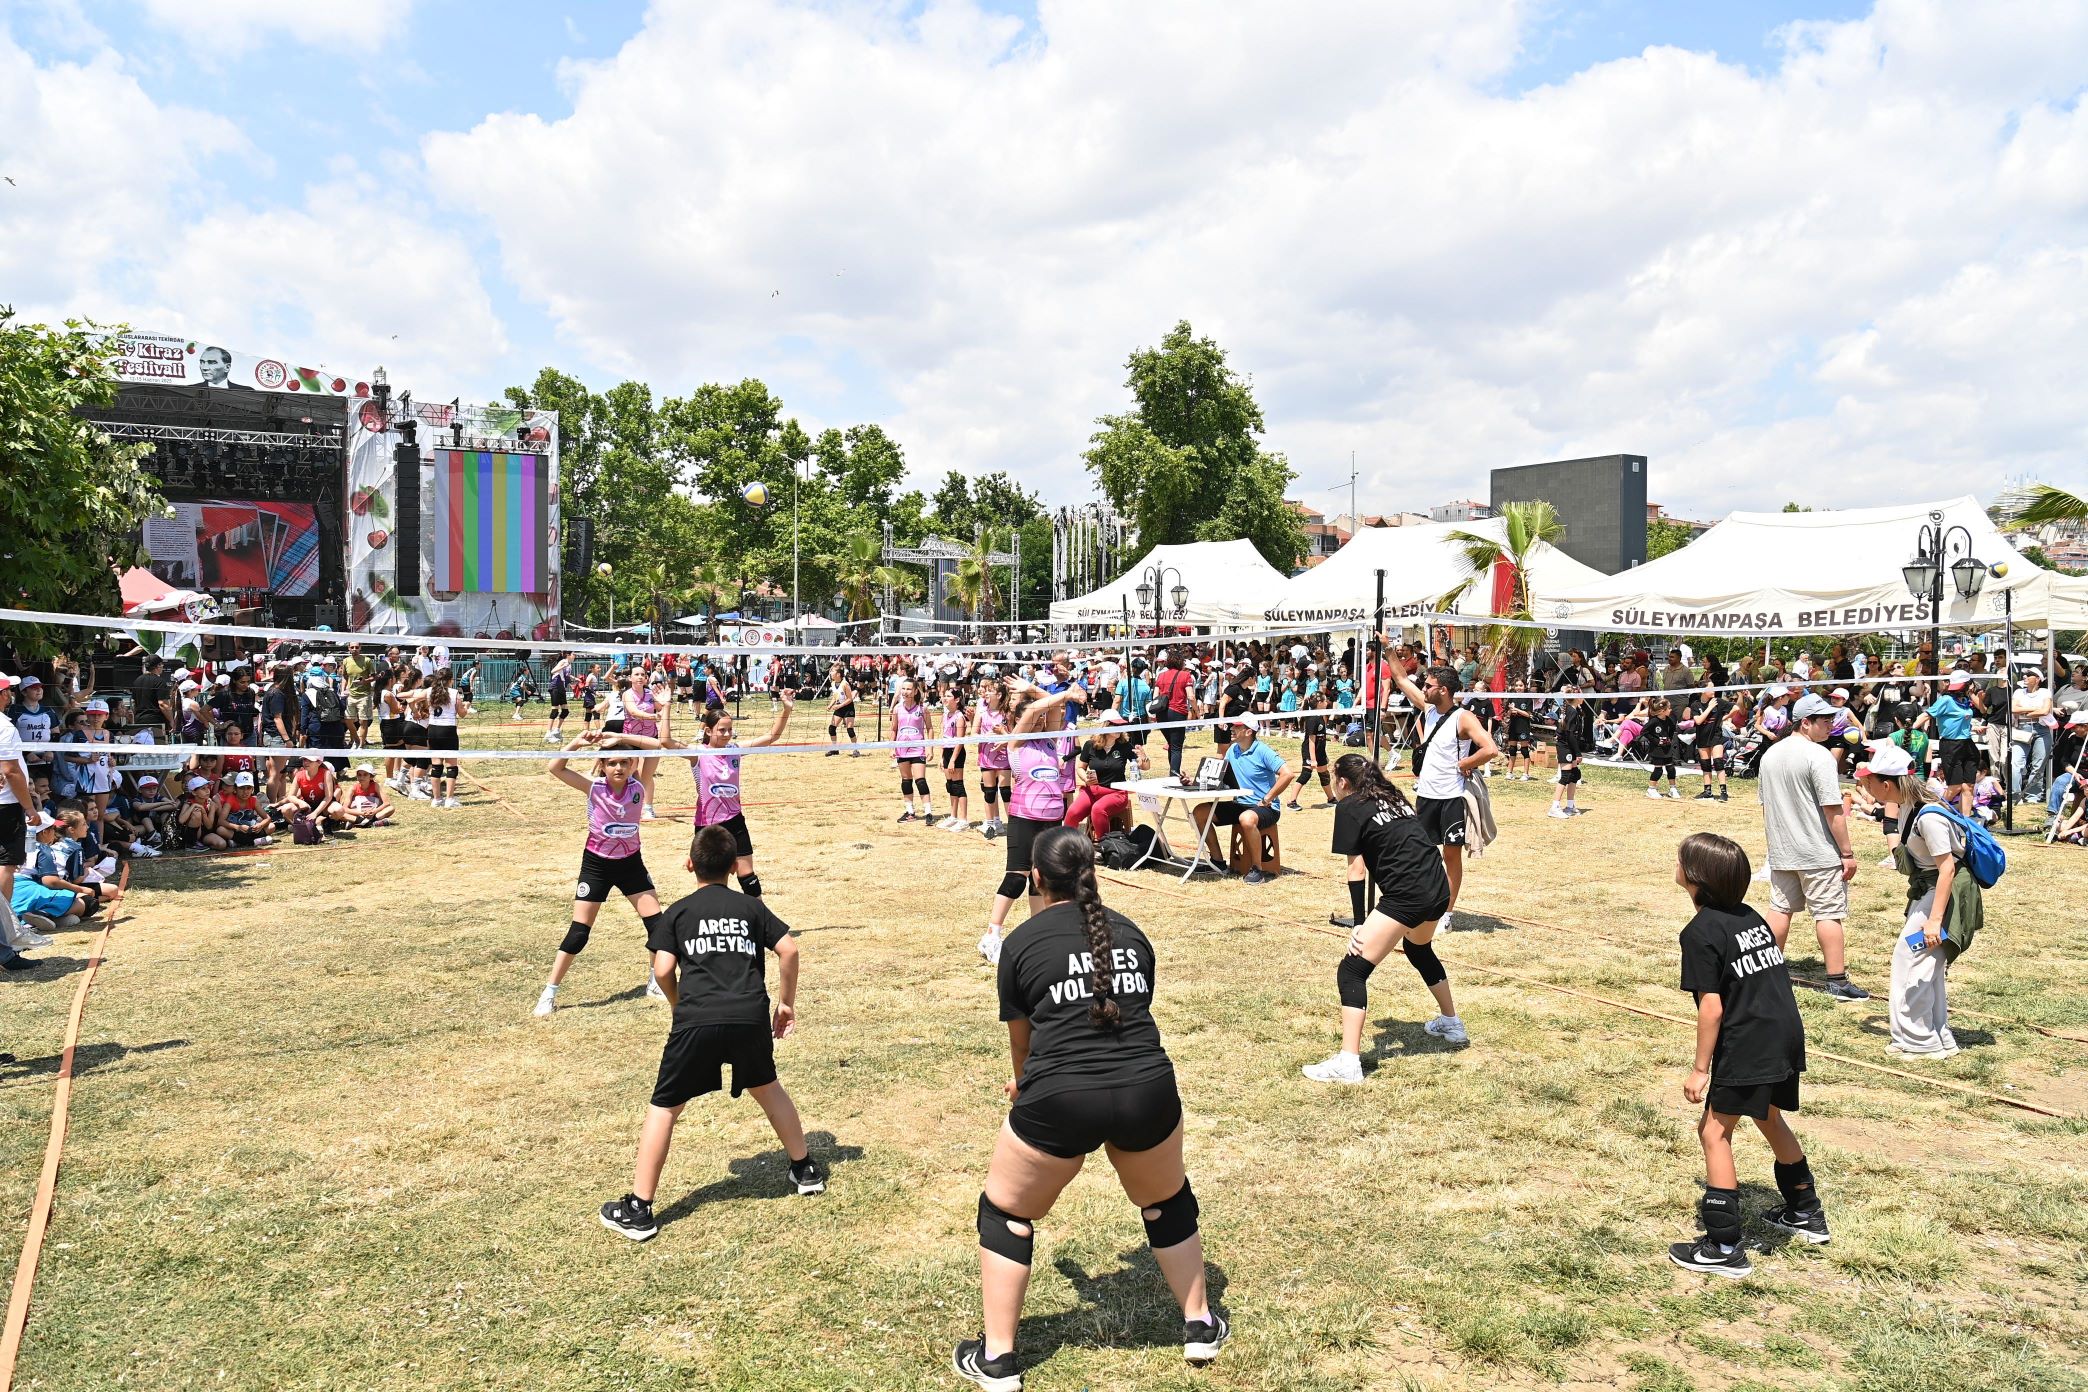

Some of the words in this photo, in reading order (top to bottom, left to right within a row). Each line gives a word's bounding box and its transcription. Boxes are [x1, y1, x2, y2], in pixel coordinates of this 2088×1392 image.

[138, 343, 183, 361] Kiraz
[117, 359, 185, 378] Festivali
[1611, 607, 1783, 630] SÜLEYMANPAŞA
[1798, 601, 1930, 628] BELEDİYES
[31, 731, 42, 741] 14
[239, 758, 250, 770] 25
[309, 789, 315, 801] 4
[616, 805, 626, 819] 4
[698, 918, 749, 937] ARGES
[1735, 924, 1772, 953] ARGES
[1068, 948, 1139, 976] ARES
[1049, 971, 1149, 1005] VOLYBO
